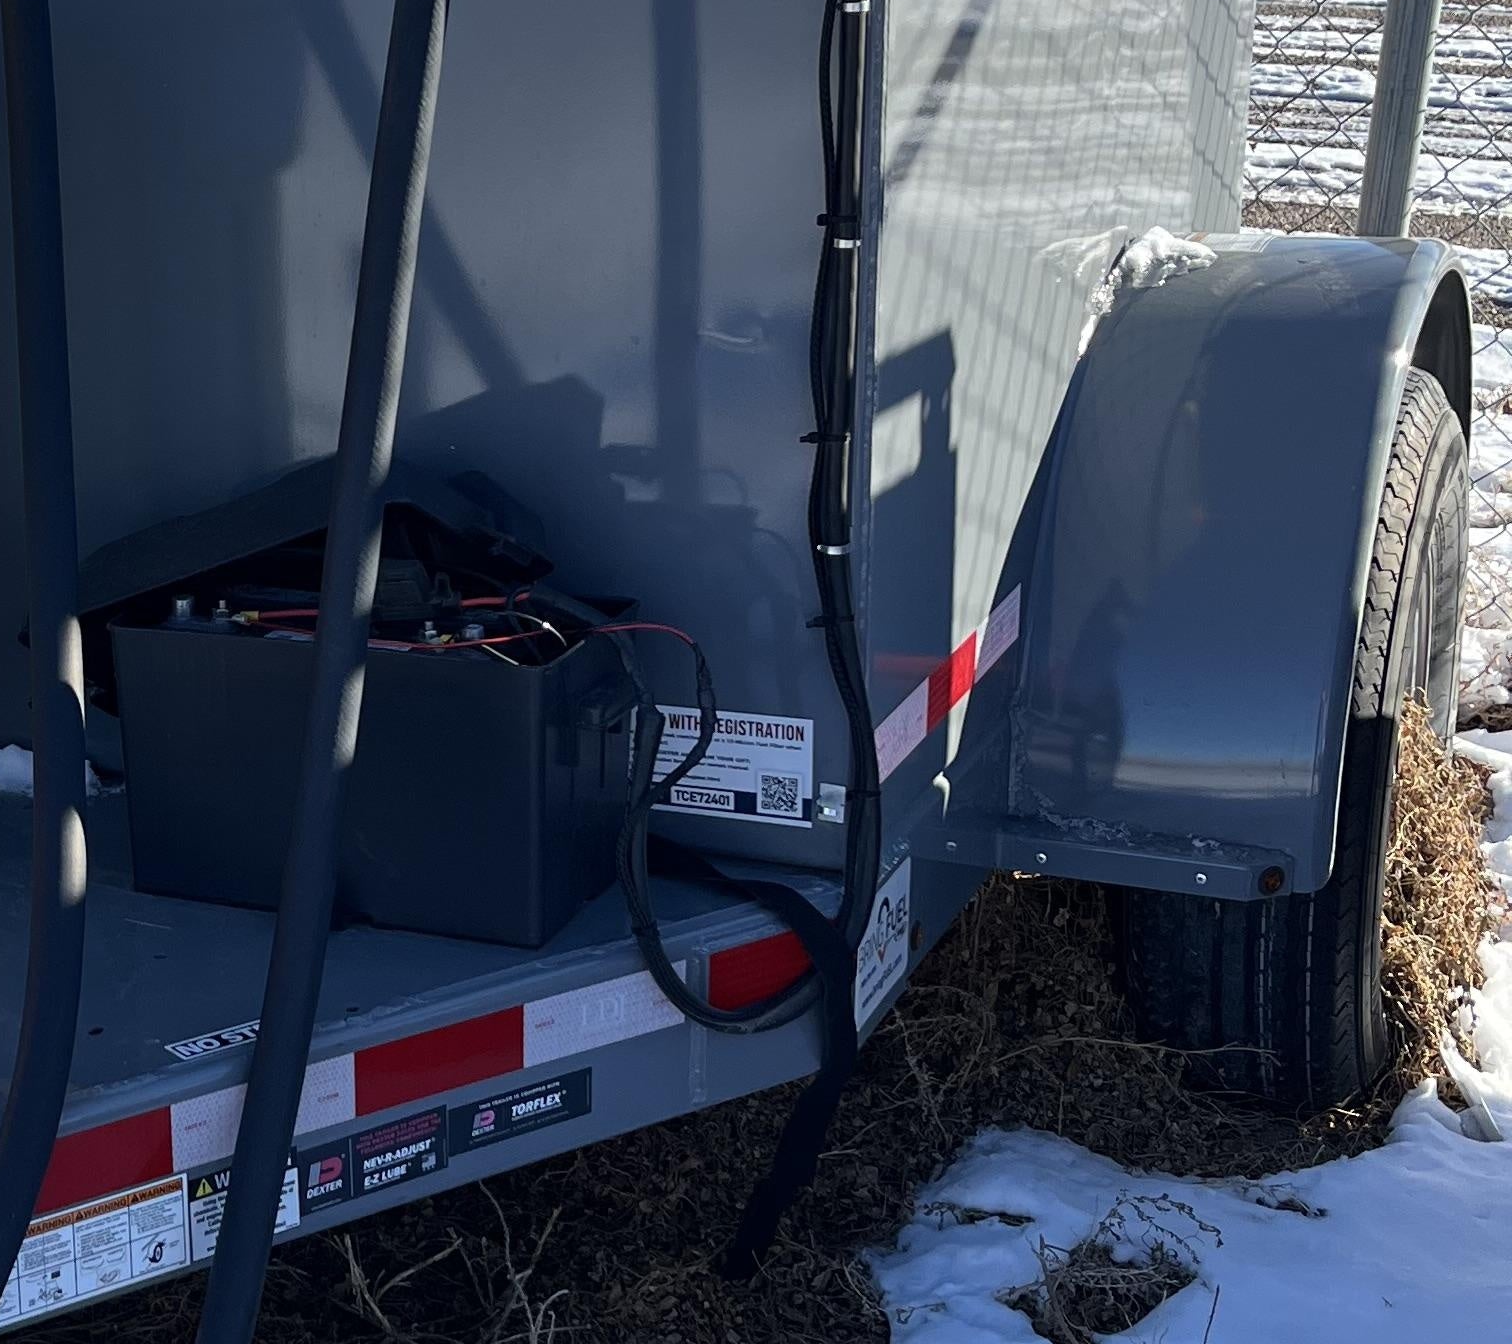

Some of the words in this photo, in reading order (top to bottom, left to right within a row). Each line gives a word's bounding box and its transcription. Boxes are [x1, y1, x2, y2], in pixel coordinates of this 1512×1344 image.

[714, 718, 805, 742] EGISTRATION
[674, 789, 730, 806] TCE72401
[175, 1038, 220, 1056] NO
[511, 1091, 561, 1117] TORFLEX
[364, 1173, 380, 1186] E-Z
[381, 1164, 407, 1180] LUBE
[138, 1181, 181, 1201] WARNING
[307, 1179, 343, 1199] DEXTER
[83, 1199, 128, 1218] WARNING
